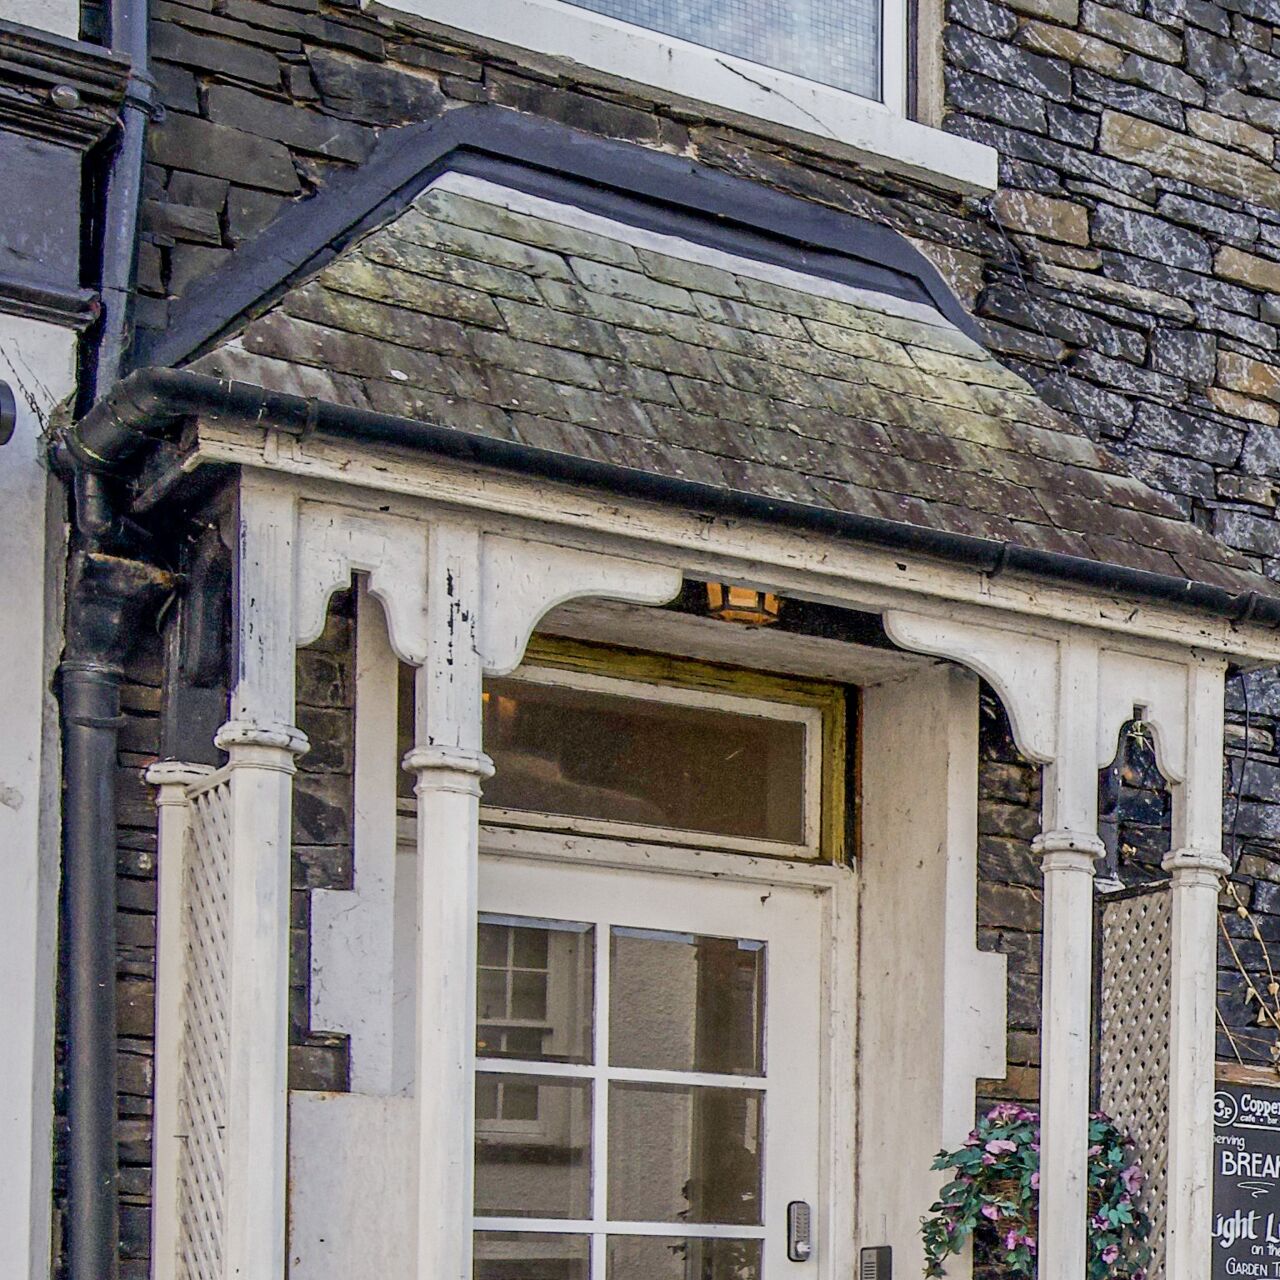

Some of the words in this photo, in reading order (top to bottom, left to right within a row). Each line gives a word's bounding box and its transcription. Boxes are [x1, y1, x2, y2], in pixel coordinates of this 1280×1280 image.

[1240, 1114, 1256, 1123] cafe
[1267, 1114, 1278, 1124] bar
[1211, 1209, 1262, 1248] ight
[1226, 1257, 1268, 1276] GARDEN
